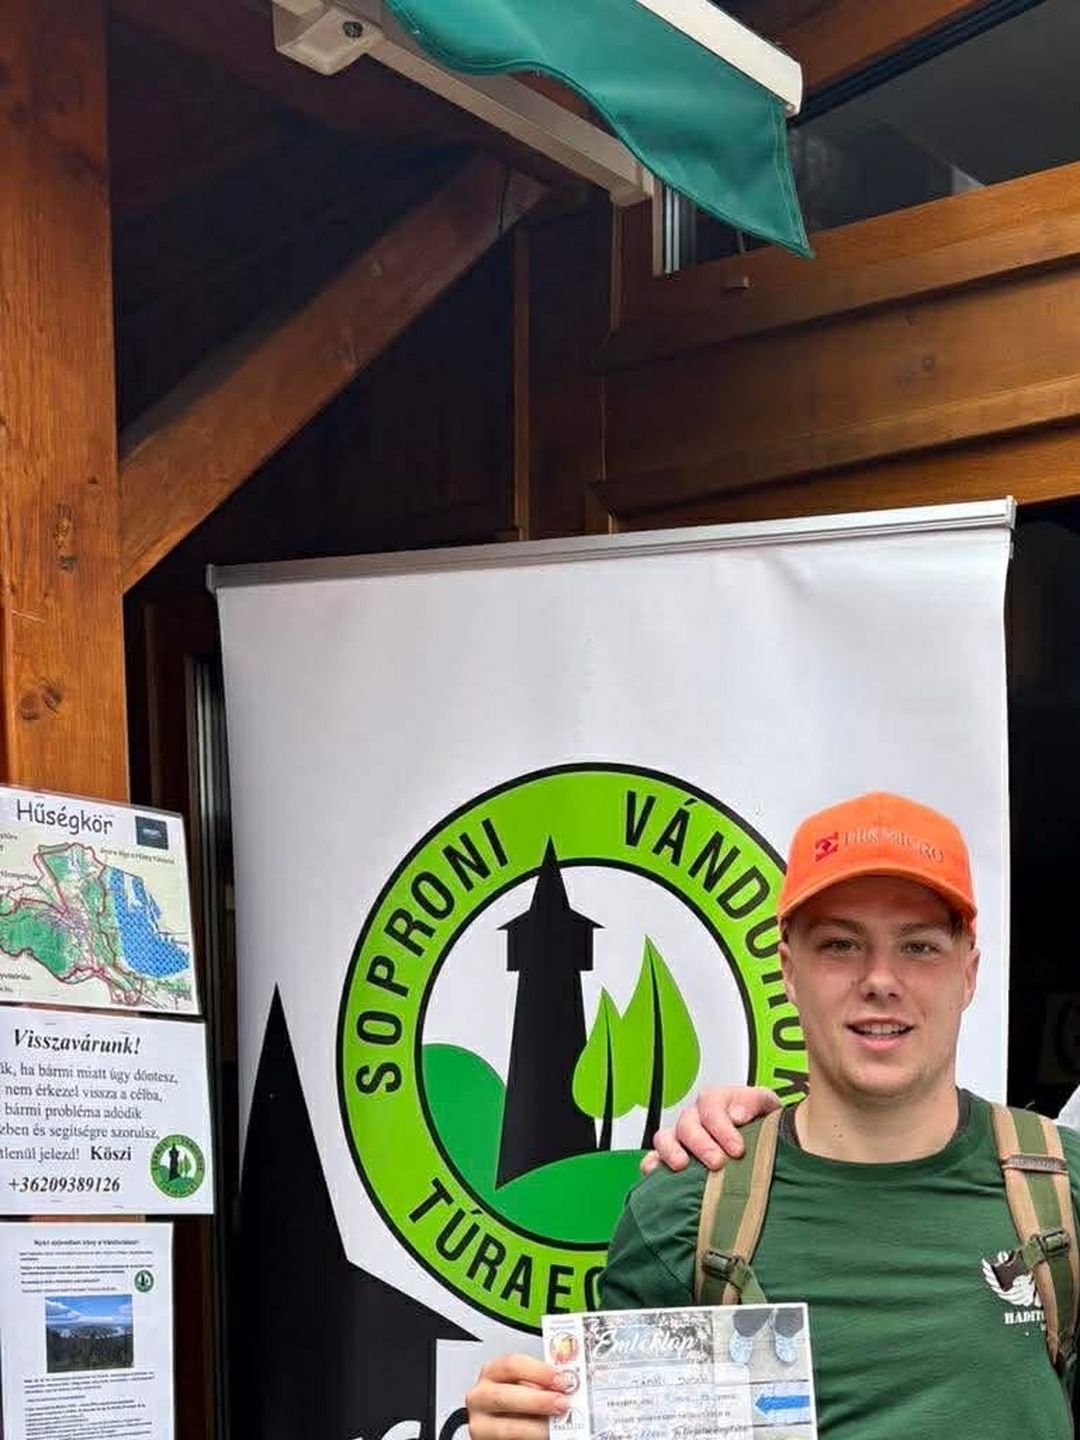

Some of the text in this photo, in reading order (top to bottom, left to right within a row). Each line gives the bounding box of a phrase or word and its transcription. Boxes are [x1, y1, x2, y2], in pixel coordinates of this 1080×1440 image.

[17, 799, 113, 835] Hűségkör
[356, 817, 510, 1094] SOPRONI
[14, 1028, 141, 1055] Visszavárunk!
[20, 1064, 35, 1076] ha
[38, 1064, 73, 1077] bármi
[77, 1067, 107, 1080] miatt
[134, 1068, 178, 1084] döntesz,
[5, 1083, 162, 1103] nem érkezel vissza a célba,
[5, 1102, 142, 1120] bármi probléma adódik
[33, 1123, 46, 1137] és
[49, 1124, 108, 1141] segítségre
[110, 1127, 160, 1140] szorulsz,
[38, 1146, 80, 1163] jelezd!
[91, 1146, 132, 1161] Köszi
[8, 1177, 121, 1193] +36209389126
